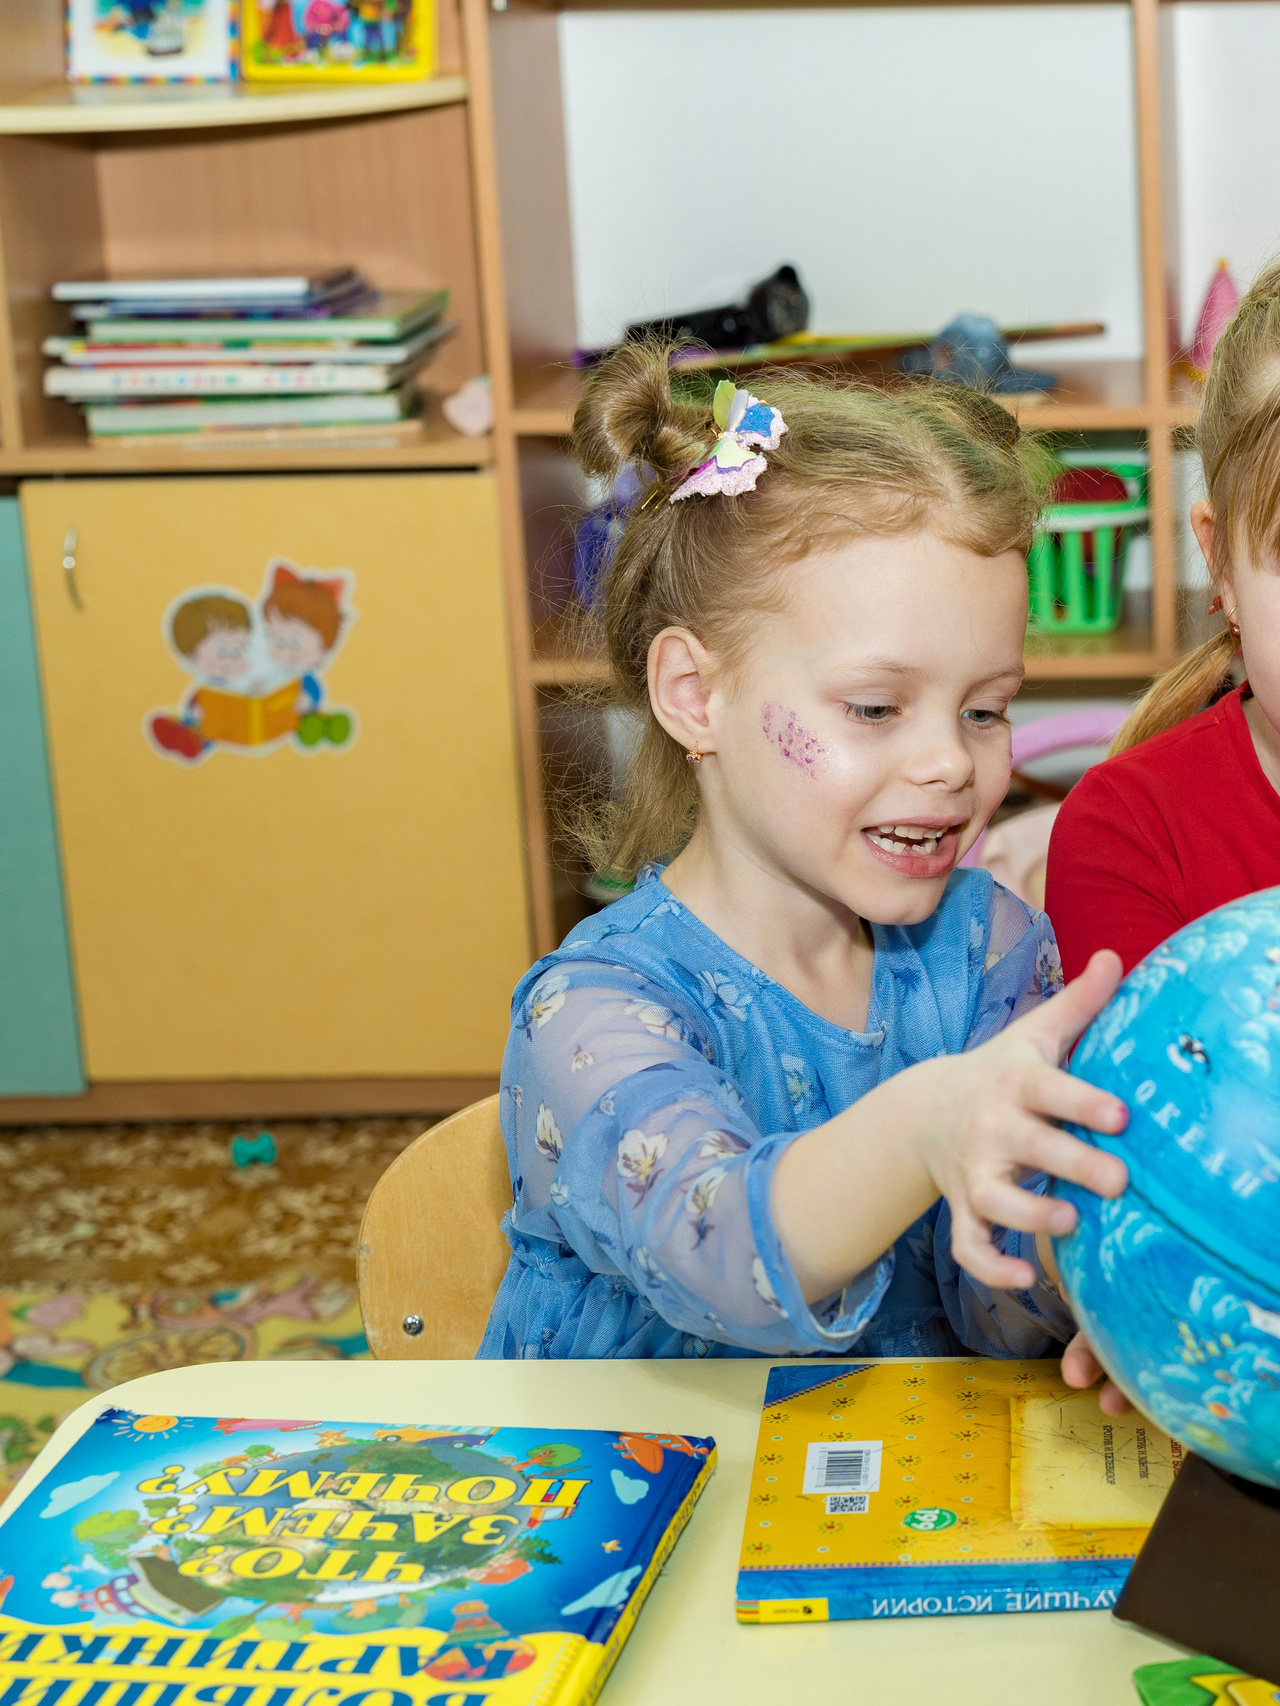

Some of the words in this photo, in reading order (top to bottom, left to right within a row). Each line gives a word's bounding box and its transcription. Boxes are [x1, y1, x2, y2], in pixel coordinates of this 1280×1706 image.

[1133, 1078, 1263, 1199] ОКЕАН
[137, 1465, 592, 1509] ПОЧЕМУ?
[149, 1503, 520, 1546] ЗАЧЕМ?
[911, 1509, 940, 1531] 199
[178, 1545, 426, 1583] ЧТО?
[871, 1594, 994, 1617] ИСТОРИИ
[0, 1633, 521, 1682] КАРТИНКИ
